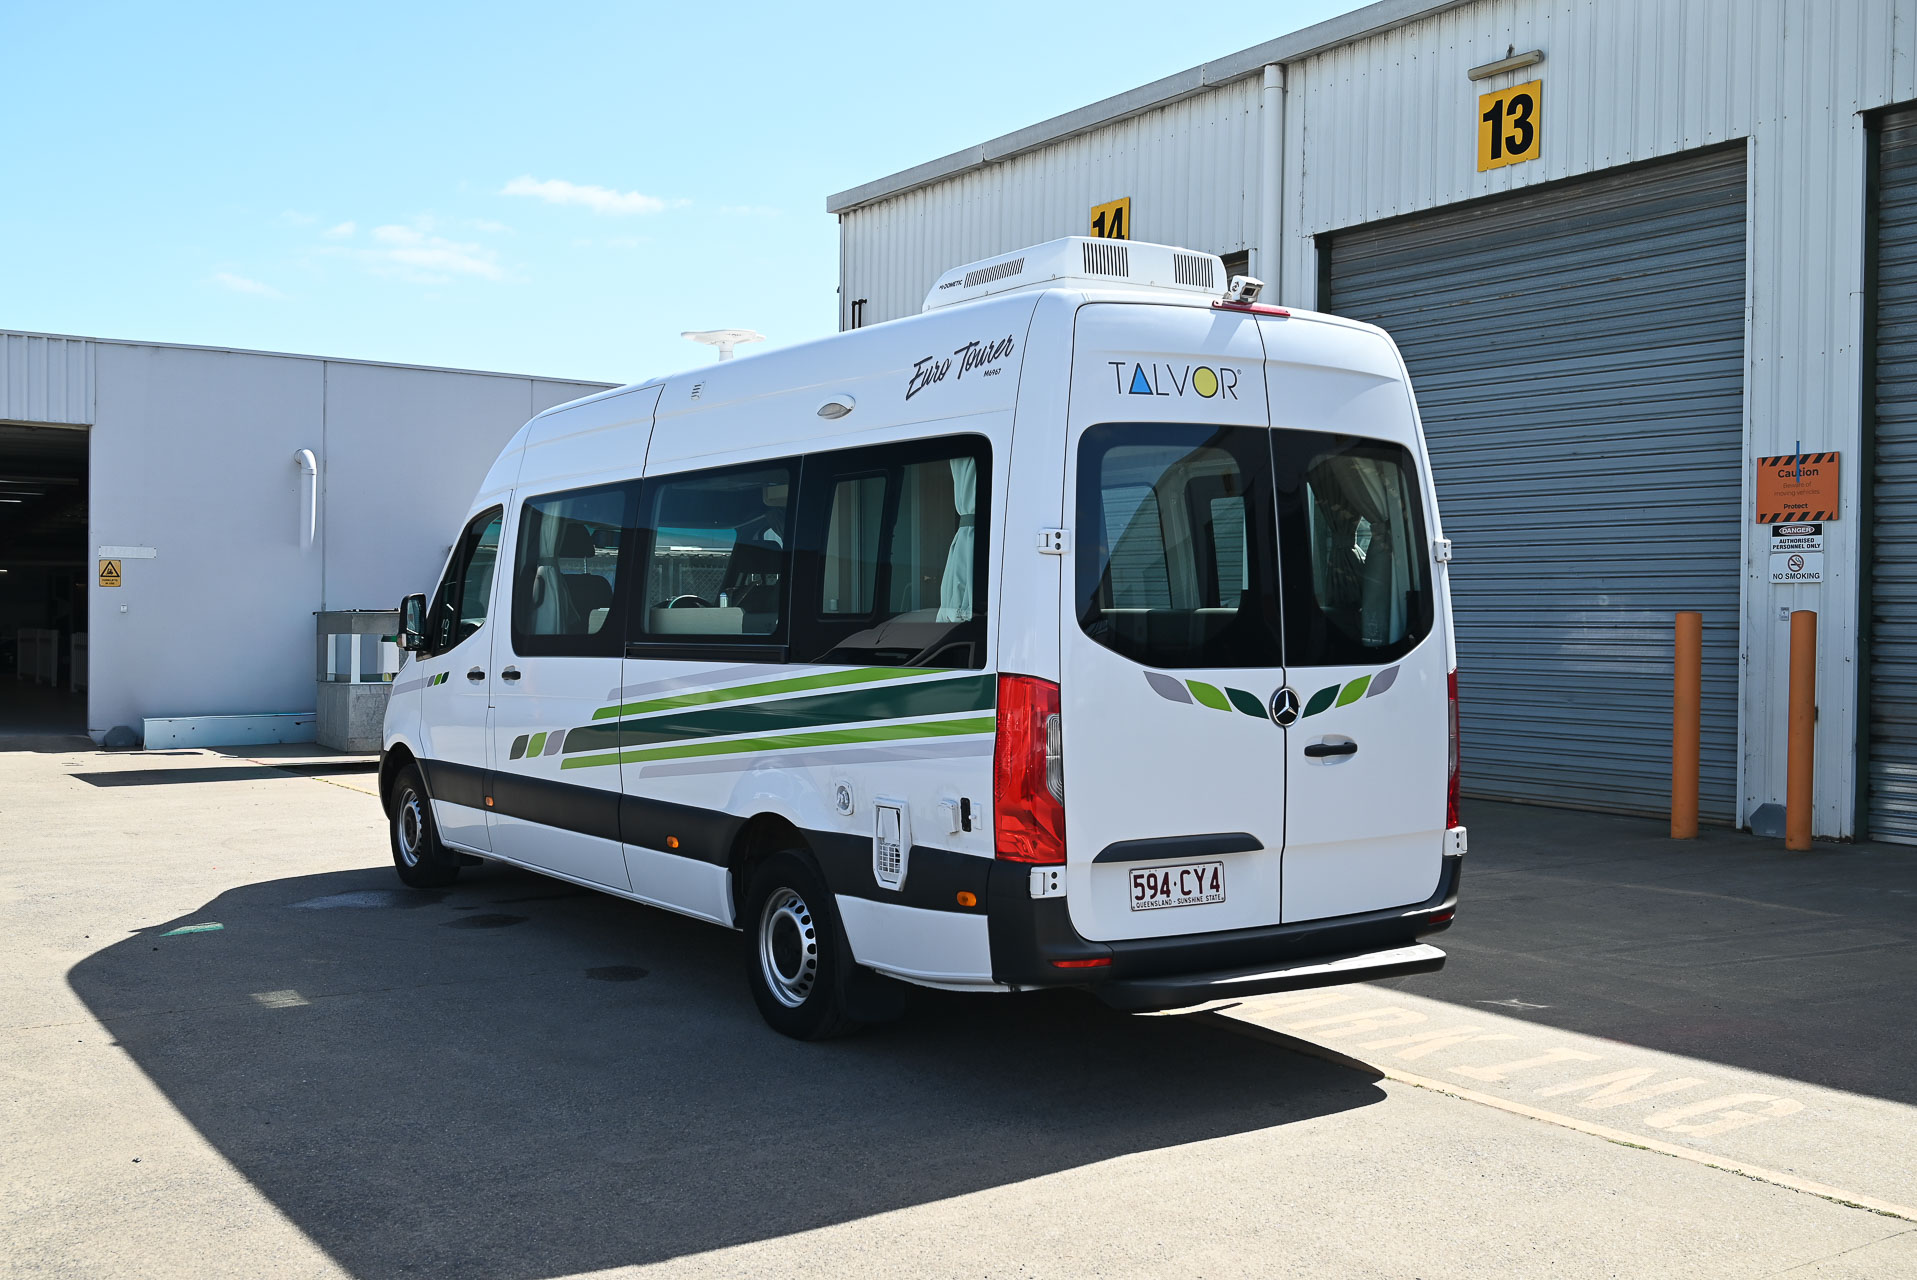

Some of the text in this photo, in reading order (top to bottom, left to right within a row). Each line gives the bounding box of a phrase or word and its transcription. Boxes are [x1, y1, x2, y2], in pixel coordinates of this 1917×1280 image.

[1483, 93, 1534, 160] 13
[1093, 207, 1125, 240] 14
[906, 334, 1014, 400] Euro Tourer
[983, 367, 1001, 377] M6967
[1108, 361, 1238, 400] TALVOR
[1777, 467, 1819, 478] Caution
[1785, 572, 1820, 580] SMOKING
[1136, 898, 1173, 909] QUEENSLAND
[1177, 896, 1204, 905] SUNSHINE
